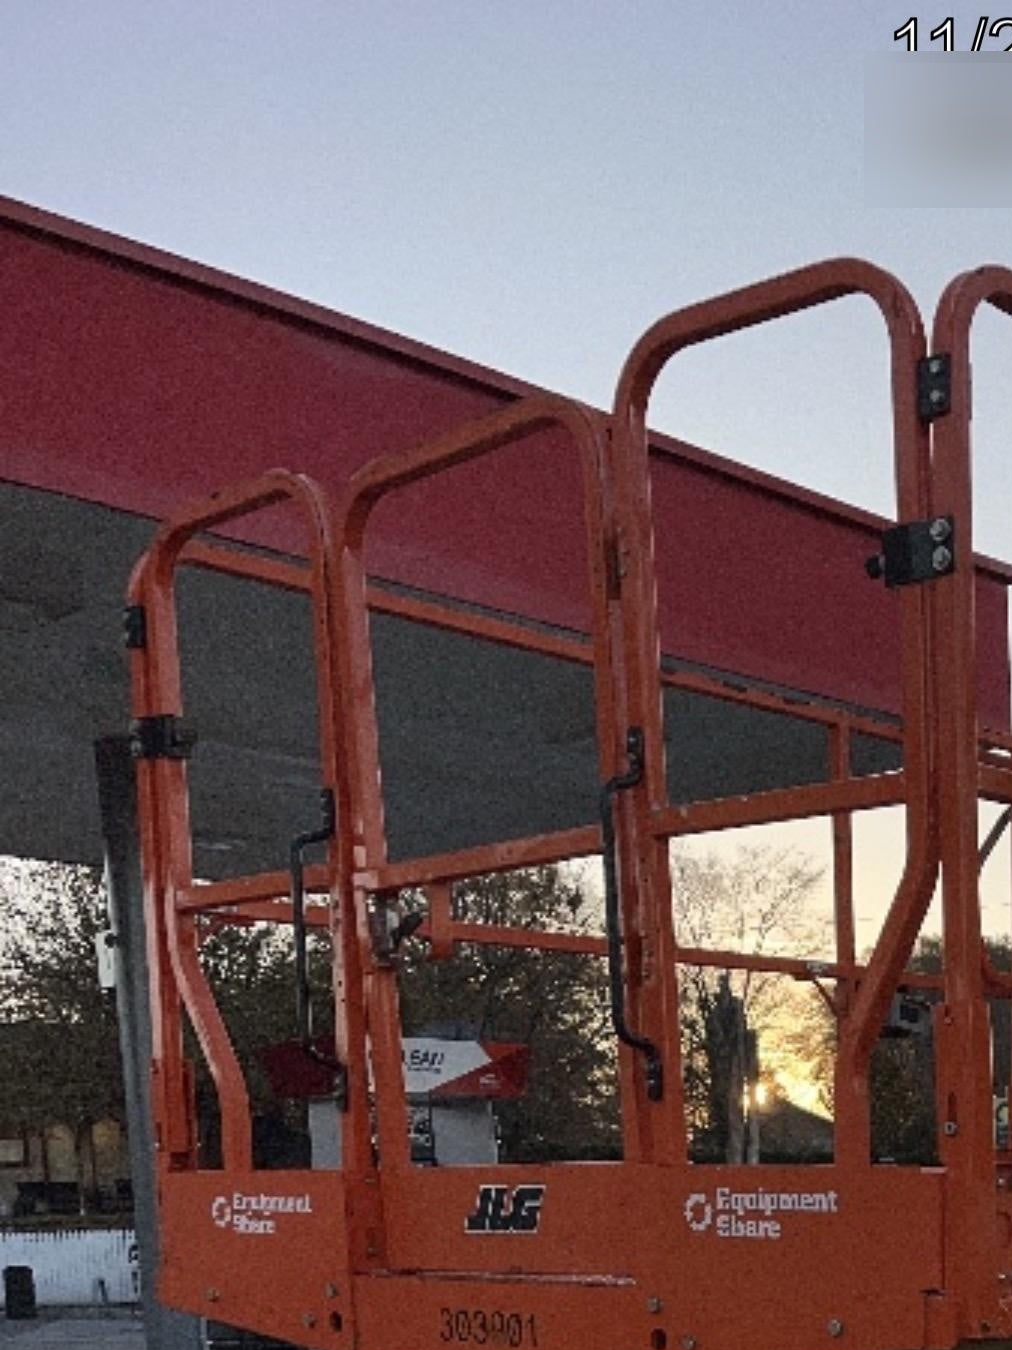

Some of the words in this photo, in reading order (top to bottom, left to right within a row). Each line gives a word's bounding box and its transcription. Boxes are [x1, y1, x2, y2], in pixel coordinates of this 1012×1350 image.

[464, 1184, 547, 1234] JLG
[715, 1187, 839, 1216] Equipment
[715, 1214, 782, 1240] Share
